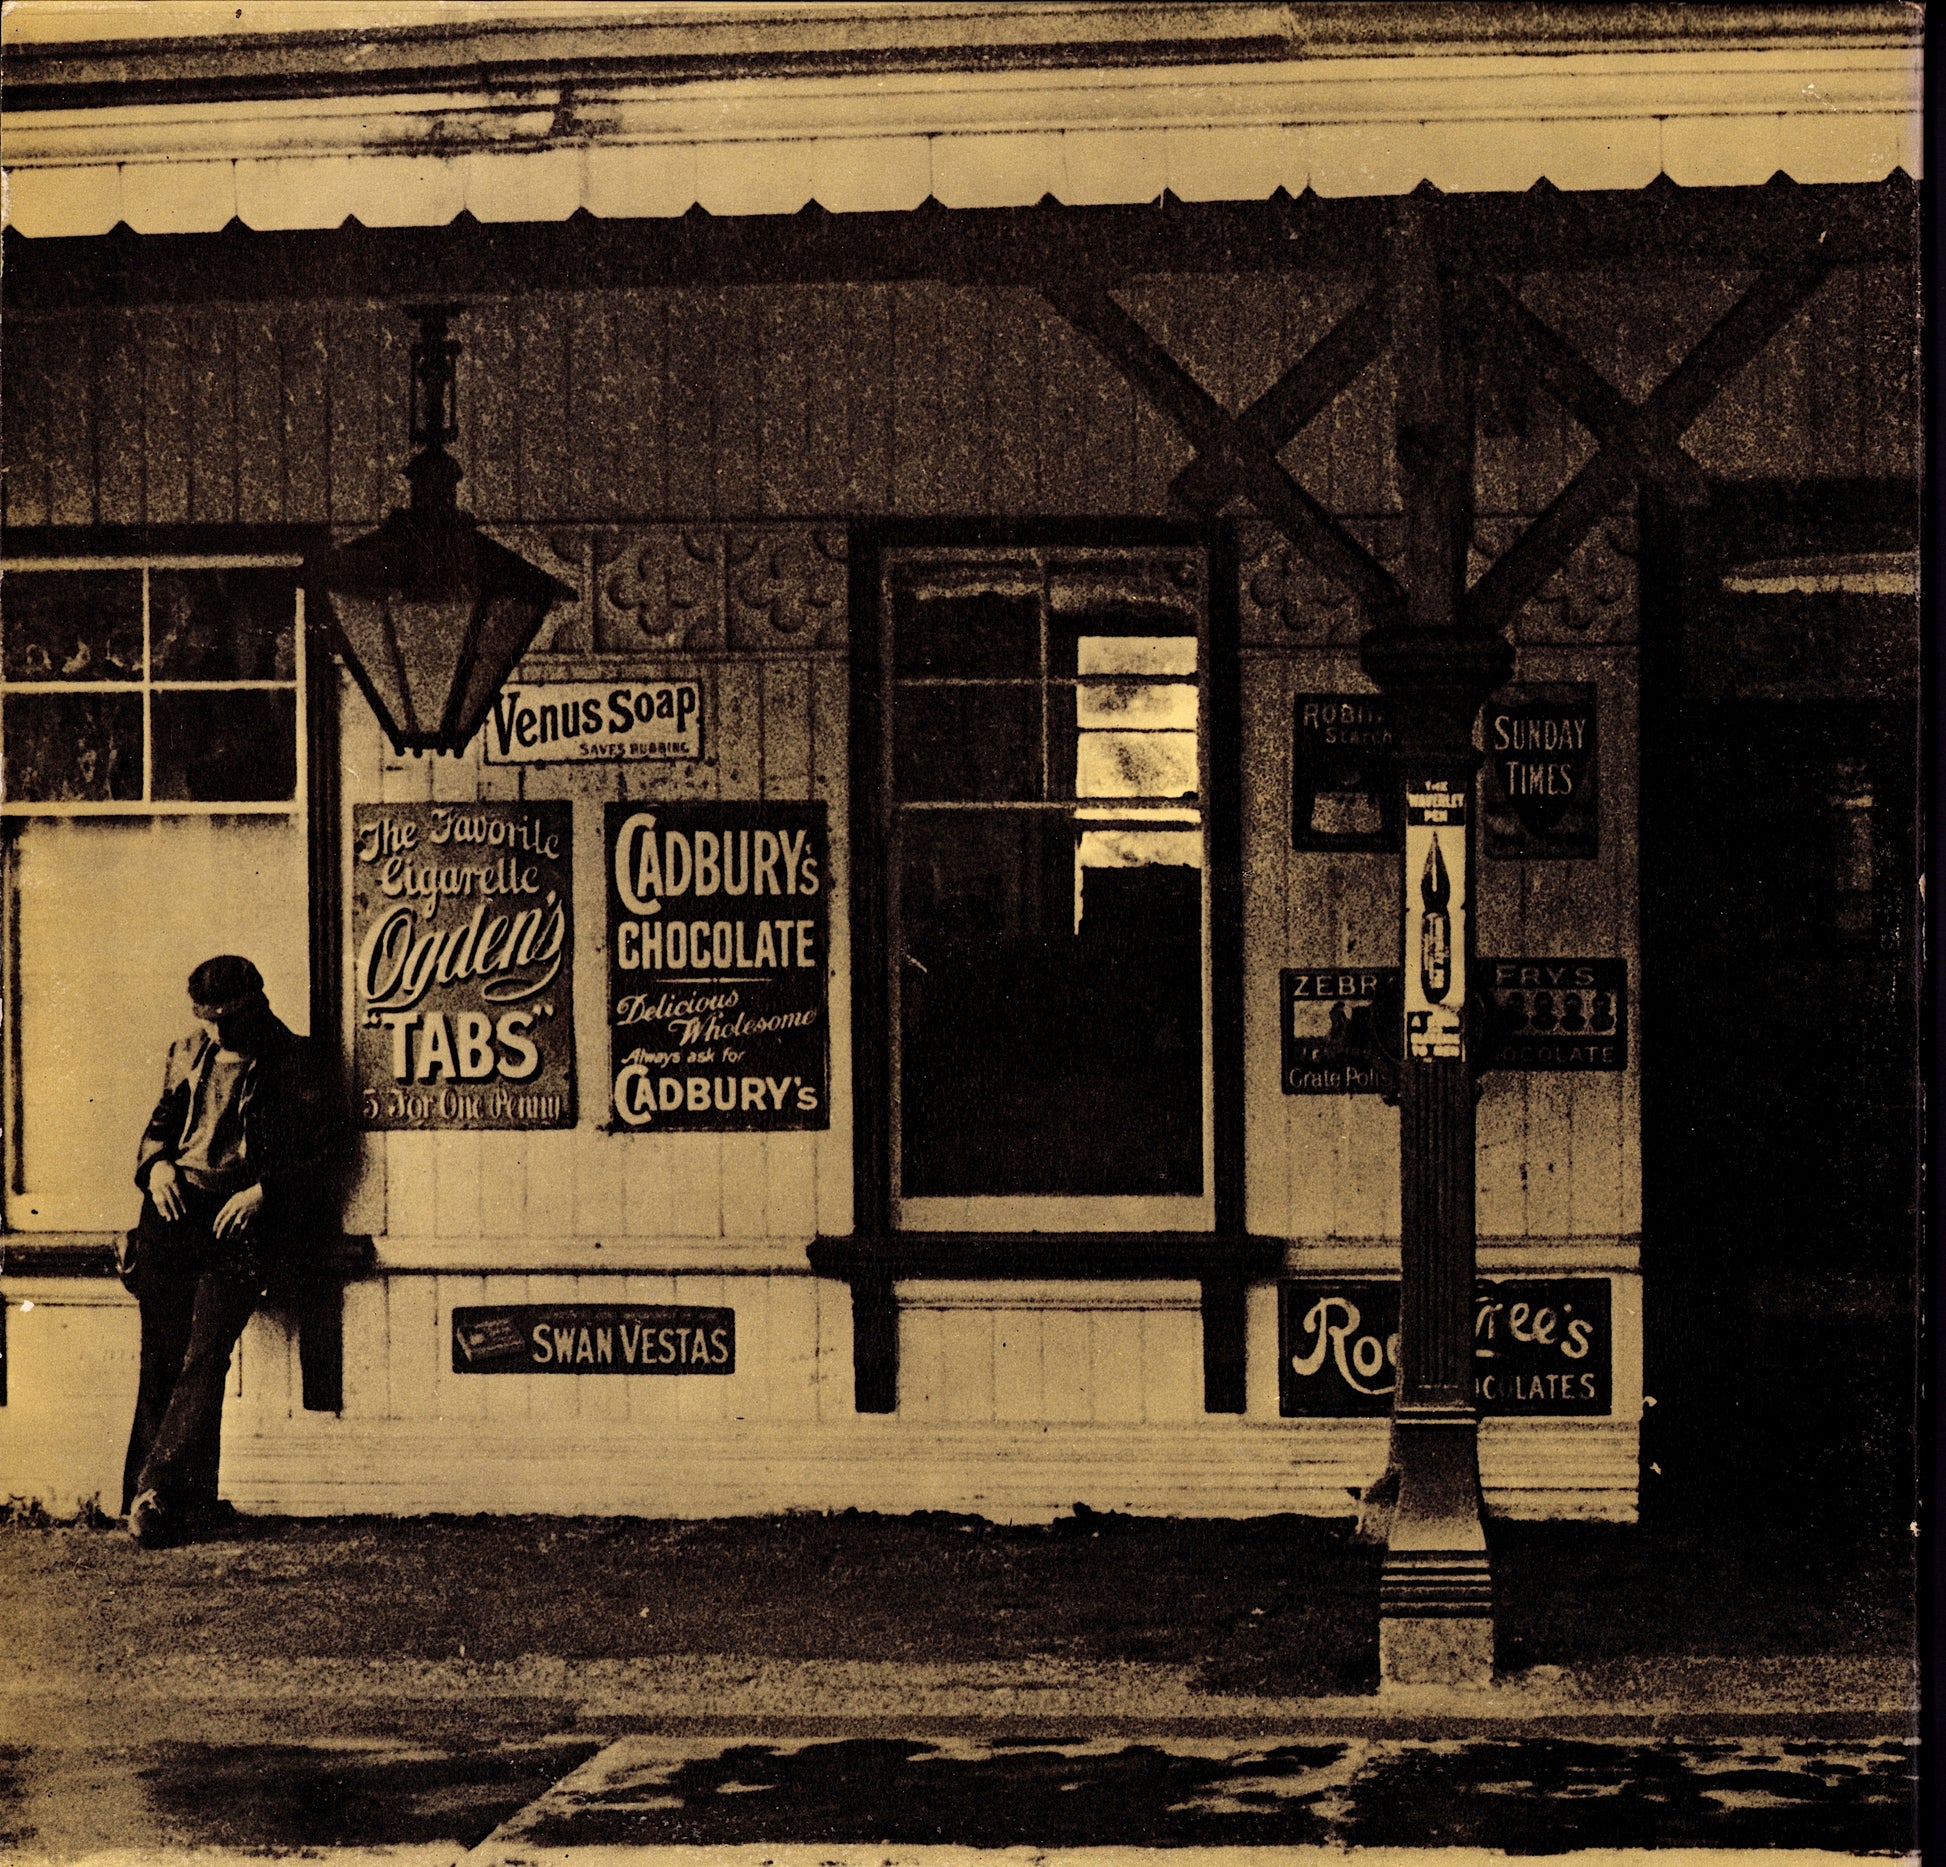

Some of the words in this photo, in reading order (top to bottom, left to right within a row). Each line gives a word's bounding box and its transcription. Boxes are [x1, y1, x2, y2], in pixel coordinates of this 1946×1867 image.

[493, 691, 603, 756] Venus
[608, 686, 696, 734] Soap
[1494, 715, 1586, 751] SUNDAY
[579, 742, 625, 756] SAVES
[1506, 761, 1572, 797] TIMES
[360, 818, 420, 862] The
[430, 809, 560, 860] Favorite
[381, 856, 540, 919] Cigarette
[358, 890, 566, 1012] Ogden's
[618, 920, 816, 970] CHOCOLATE
[1293, 975, 1393, 998] ZEBR
[616, 989, 739, 1026] Delicious
[668, 1008, 817, 1047] Wholesome
[621, 1048, 681, 1068] Always
[687, 1048, 714, 1064] ask
[722, 1047, 746, 1064] for
[1502, 1046, 1614, 1064] OCOLATE
[1289, 1067, 1342, 1088] Grate
[363, 1088, 379, 1119] 5
[442, 1088, 483, 1119] One
[532, 1323, 613, 1364] SWAN
[619, 1324, 730, 1364] VESTAS
